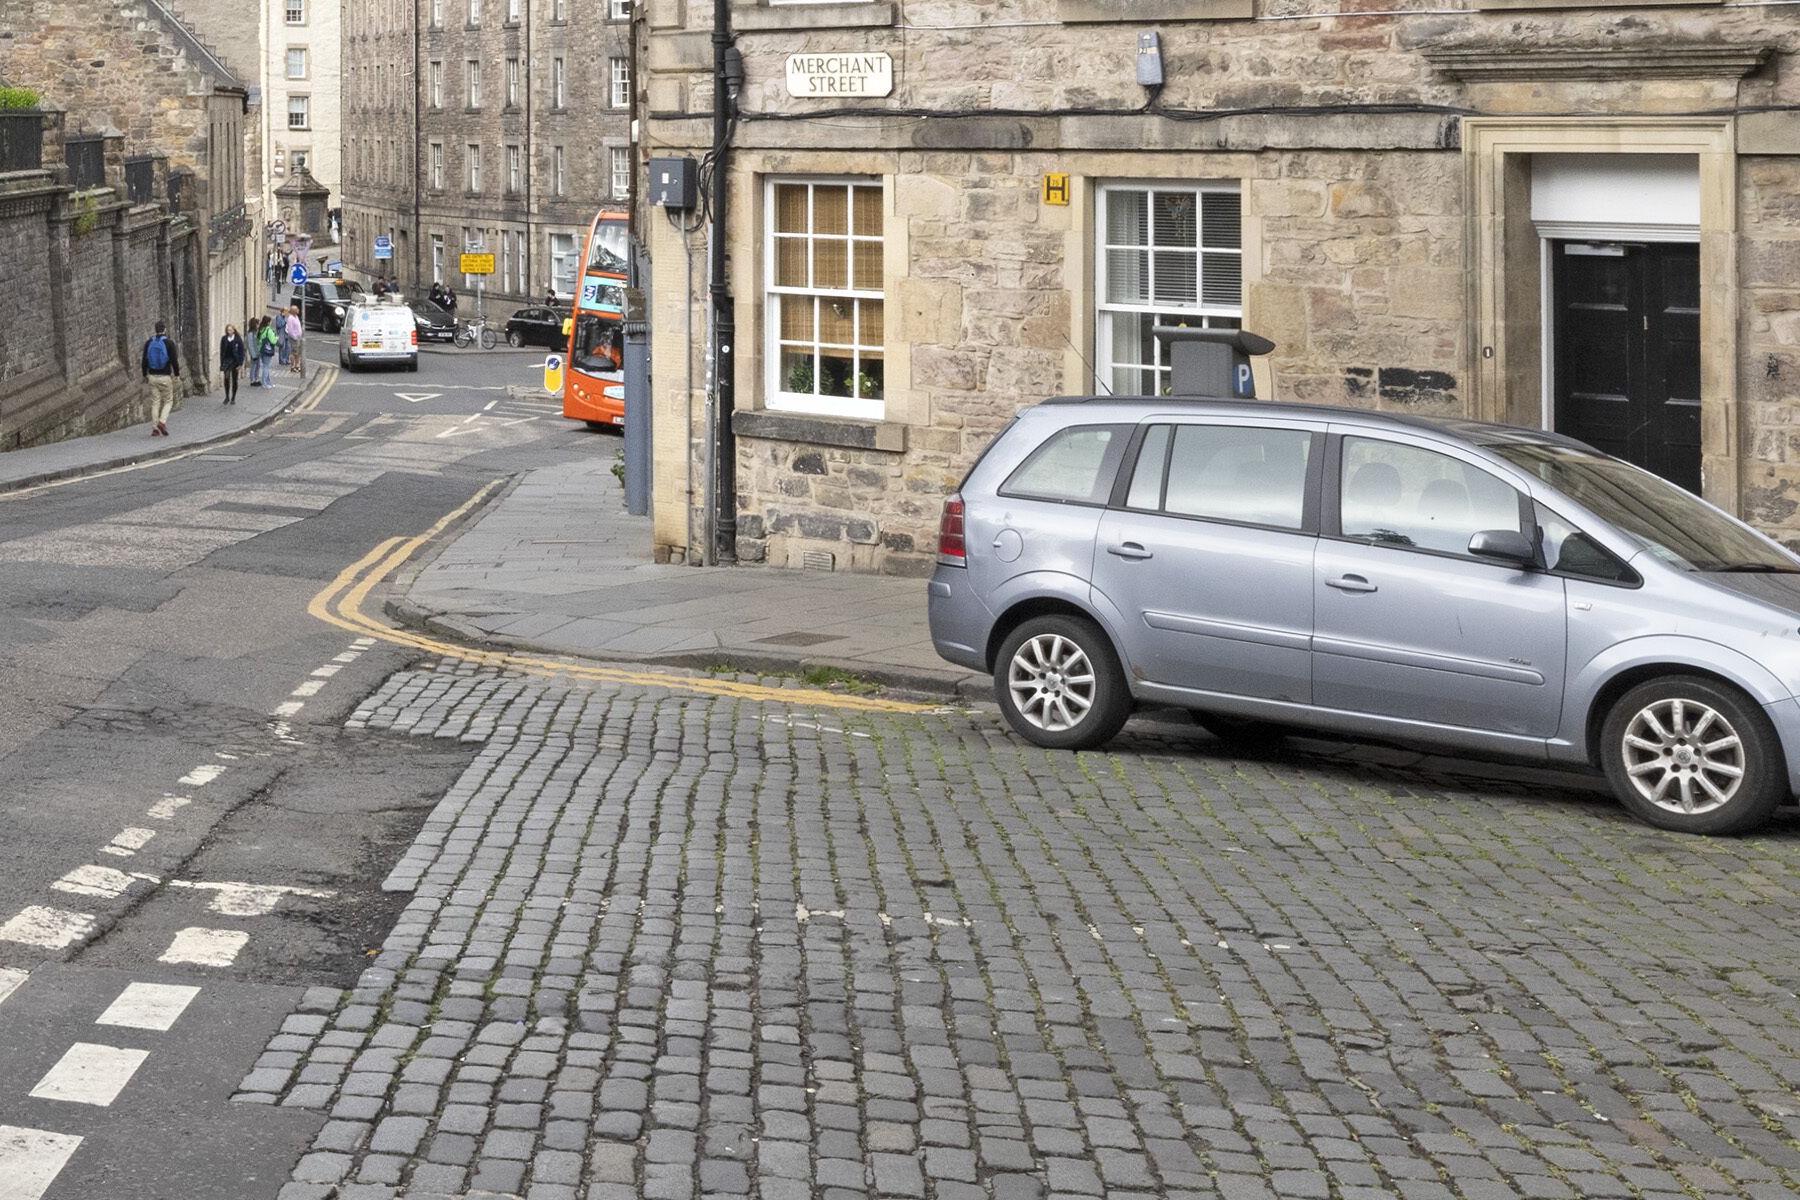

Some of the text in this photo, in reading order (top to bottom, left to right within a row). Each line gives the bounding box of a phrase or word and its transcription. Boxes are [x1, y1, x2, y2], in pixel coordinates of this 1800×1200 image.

[792, 56, 886, 74] MERCHANT
[809, 76, 868, 92] STREET
[1046, 175, 1066, 201] H
[1238, 363, 1250, 393] P
